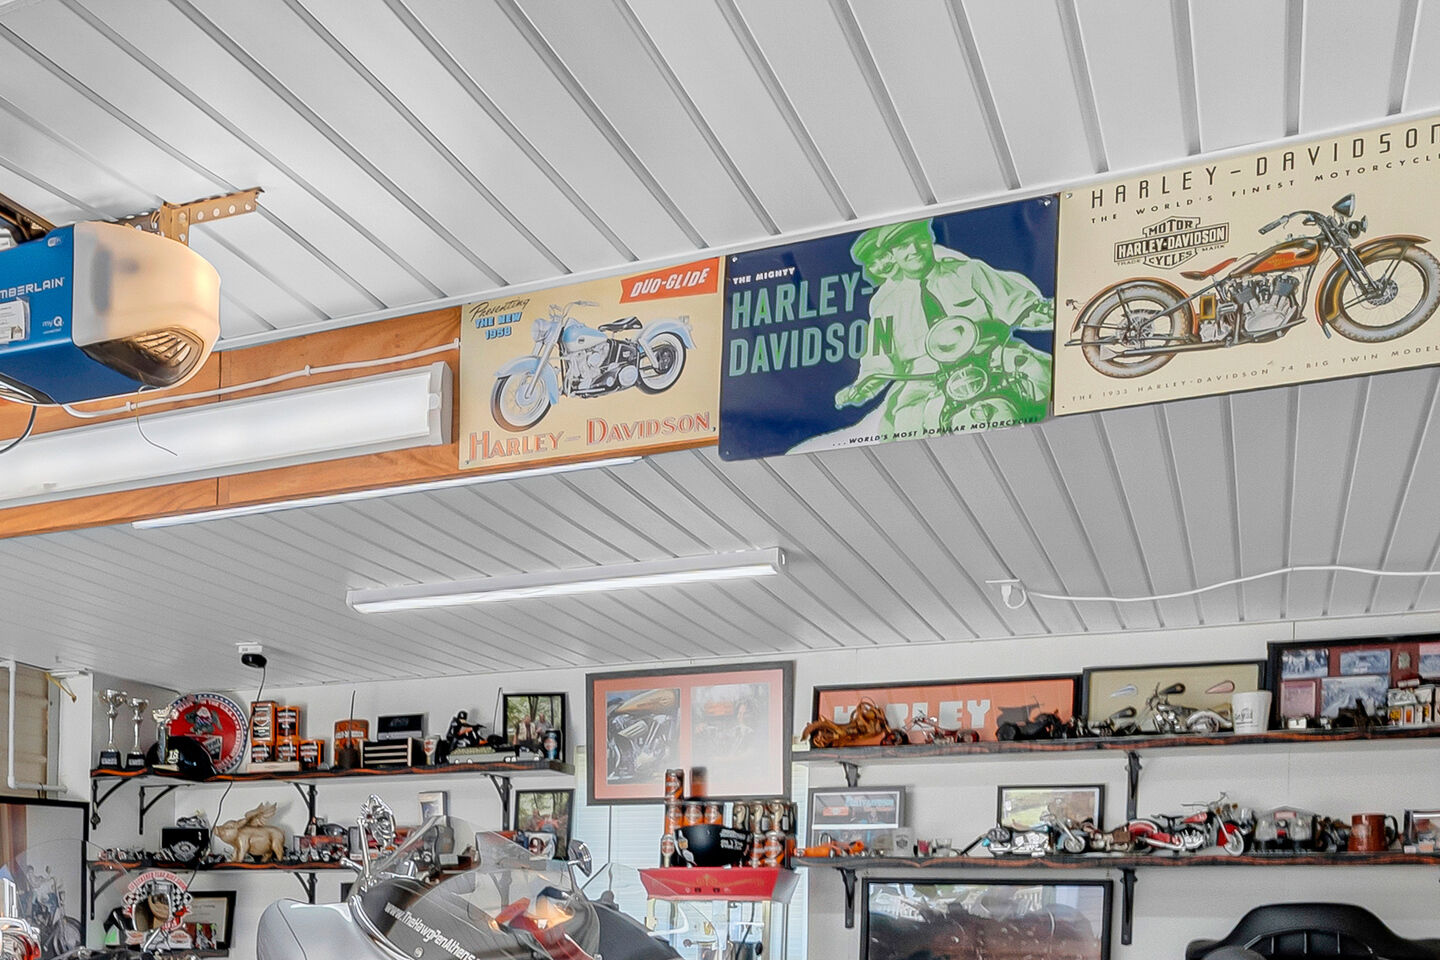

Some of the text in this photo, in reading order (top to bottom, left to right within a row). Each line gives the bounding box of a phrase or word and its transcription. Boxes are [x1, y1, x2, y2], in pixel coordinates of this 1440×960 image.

[1091, 213, 1118, 224] THE
[1136, 195, 1214, 215] WORLD'S
[1232, 180, 1296, 197] FINEST
[1148, 219, 1194, 236] MOTOR
[1148, 250, 1194, 267] CYCLES
[630, 267, 711, 298] DUO-GLIDE
[733, 267, 796, 285] THE MIGHTY
[469, 298, 531, 322] Presenting
[474, 311, 523, 329] THE NEW
[728, 316, 895, 377] DAVIDSON
[1280, 363, 1295, 373] 74
[1306, 359, 1330, 370] BIG
[1341, 353, 1379, 364] TWIN
[892, 430, 918, 440] MOST
[922, 423, 966, 436] POPULAR
[834, 699, 991, 732] HRLEY
